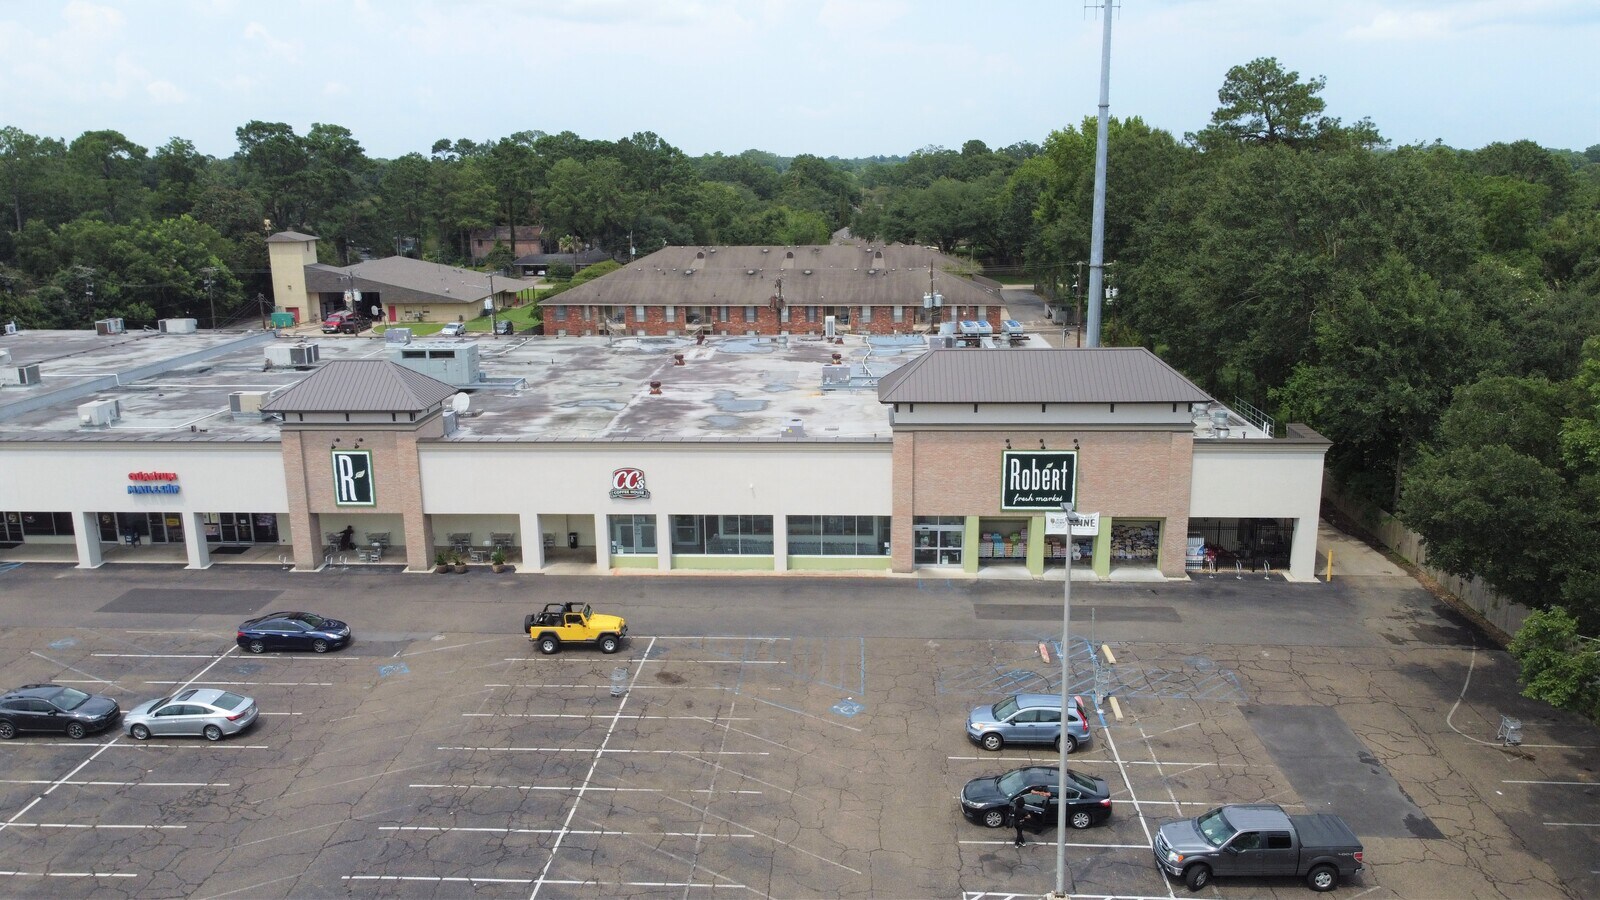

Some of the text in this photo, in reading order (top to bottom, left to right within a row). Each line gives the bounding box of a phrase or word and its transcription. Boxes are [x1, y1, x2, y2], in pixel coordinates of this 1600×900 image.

[338, 454, 358, 501] R
[1013, 493, 1063, 505] fresh market
